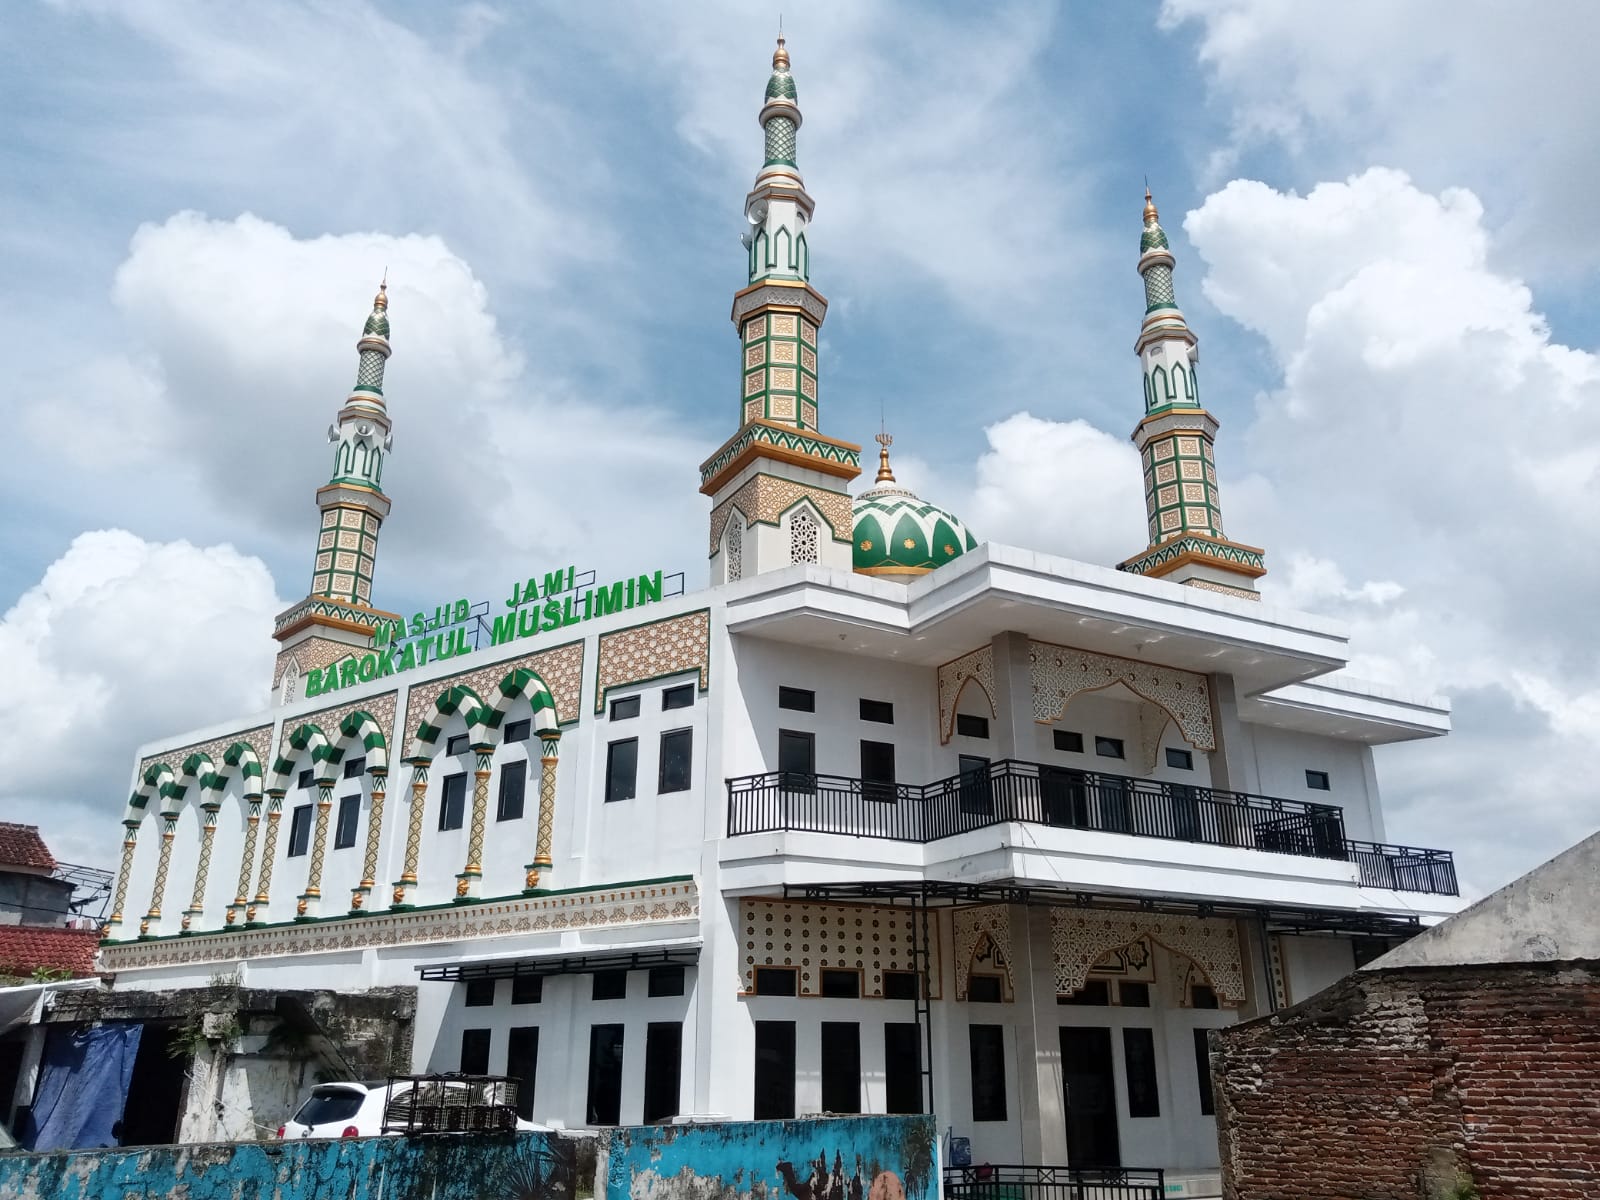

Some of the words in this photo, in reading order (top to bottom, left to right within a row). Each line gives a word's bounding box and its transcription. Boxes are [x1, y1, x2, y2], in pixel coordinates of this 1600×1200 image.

[305, 627, 472, 698] BAROKATUL
[491, 570, 663, 646] MUSLIMIN
[374, 599, 471, 648] MASJID
[506, 565, 575, 608] JAMI
